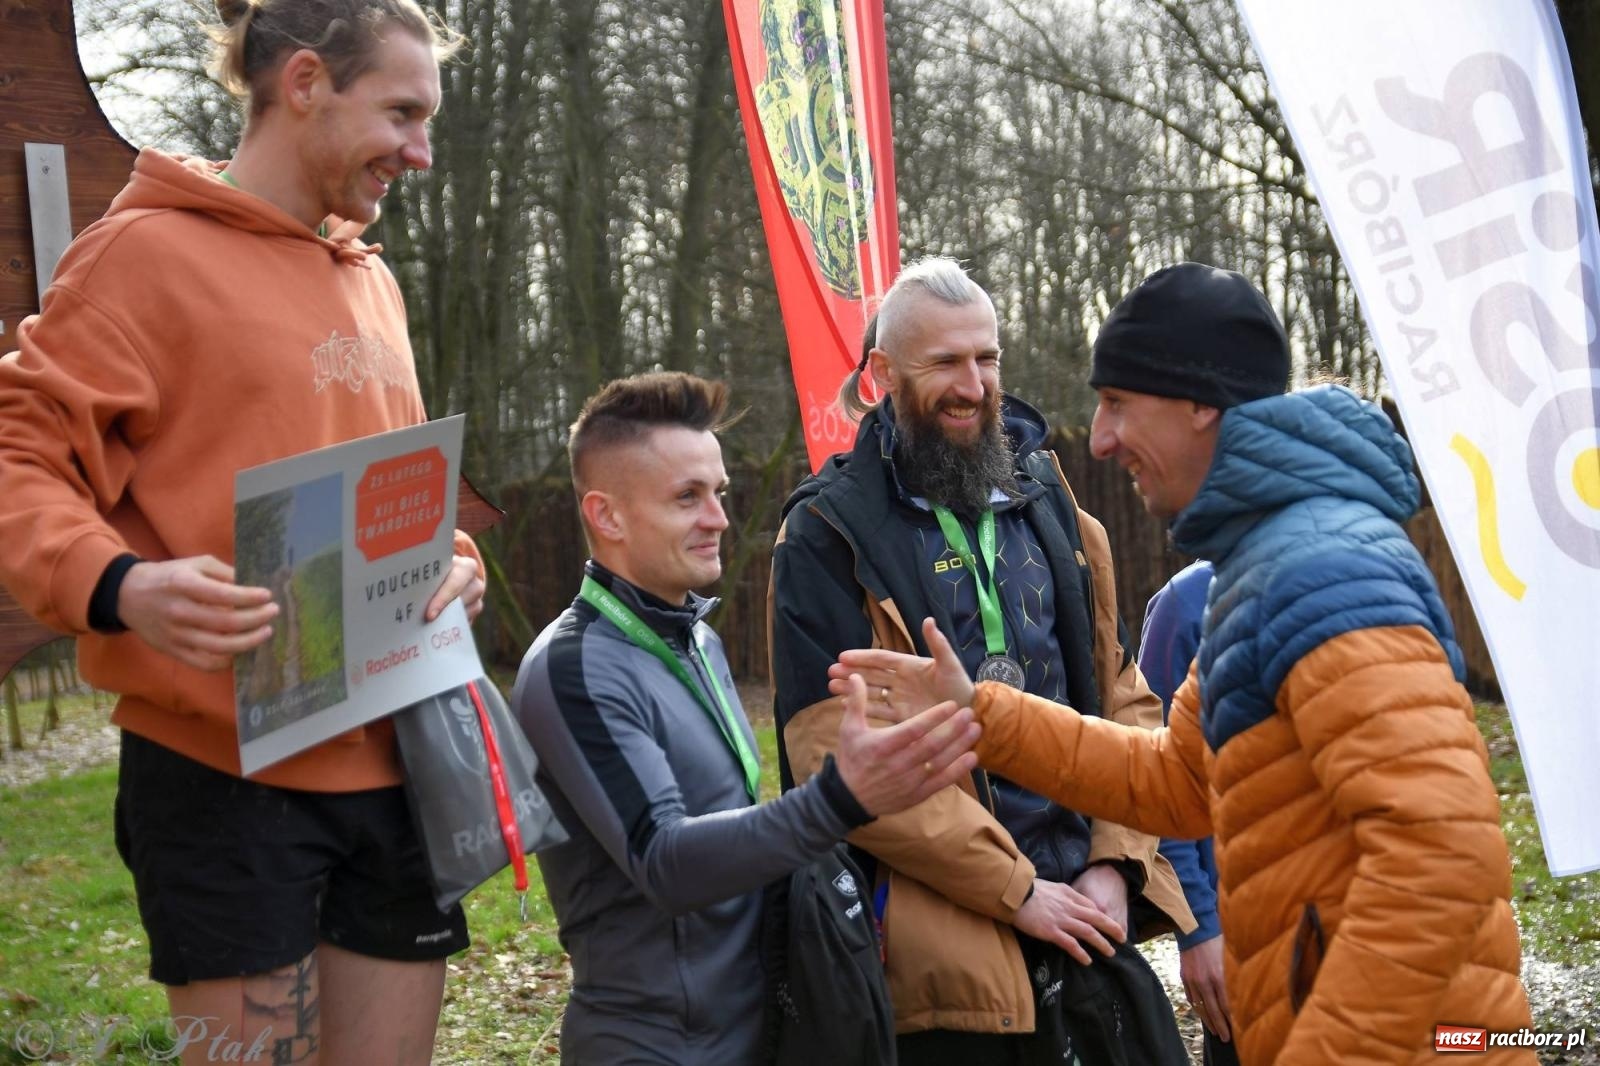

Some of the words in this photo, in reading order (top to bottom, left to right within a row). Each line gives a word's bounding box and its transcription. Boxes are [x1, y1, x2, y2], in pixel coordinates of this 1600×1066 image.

[388, 460, 432, 482] LUTEGO
[374, 501, 393, 519] XII
[400, 490, 430, 511] BIEG
[357, 503, 441, 541] TWARDZIELA
[366, 560, 440, 601] VOUCHER
[395, 602, 413, 622] 4F
[365, 645, 420, 676] Racibórz
[431, 626, 461, 650] OSiR
